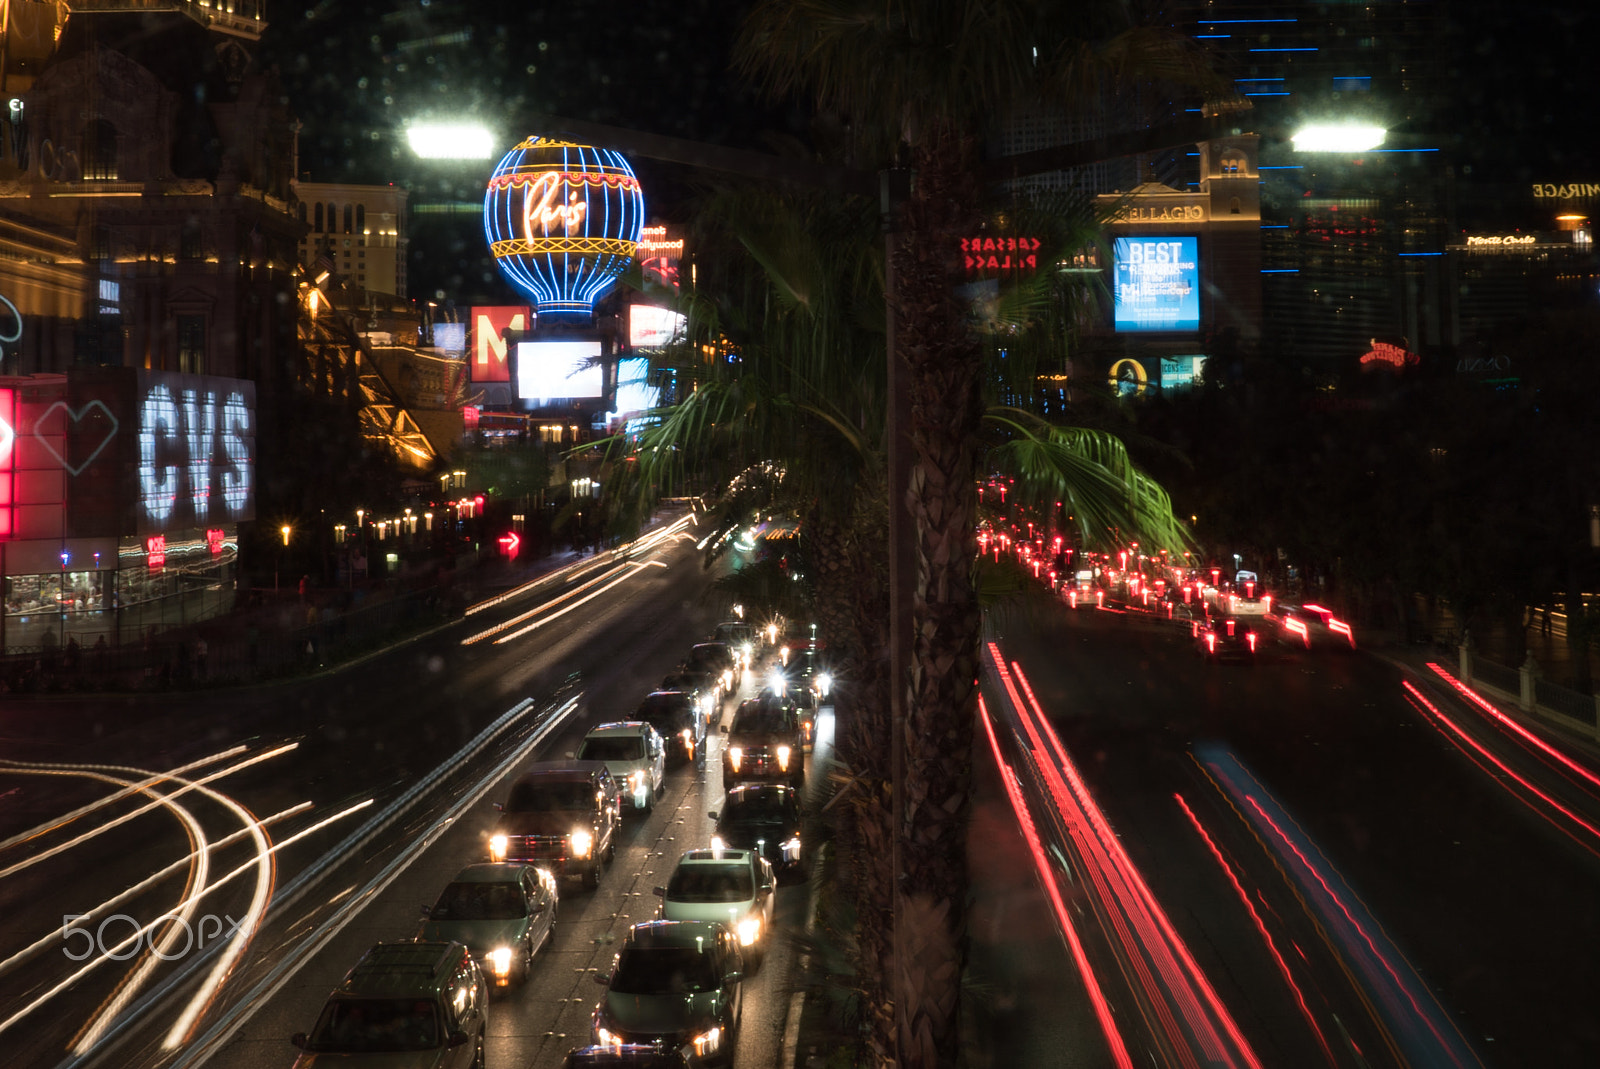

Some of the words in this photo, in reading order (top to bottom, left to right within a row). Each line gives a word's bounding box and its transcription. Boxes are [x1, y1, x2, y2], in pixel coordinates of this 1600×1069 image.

[523, 171, 587, 245] Paris
[1121, 205, 1204, 220] ELLAGIO
[641, 225, 667, 235] anet
[636, 239, 684, 251] ollywood
[1467, 236, 1502, 246] Monte
[1502, 235, 1536, 245] Carlo
[1129, 242, 1182, 264] BEST
[139, 384, 250, 520] CVS
